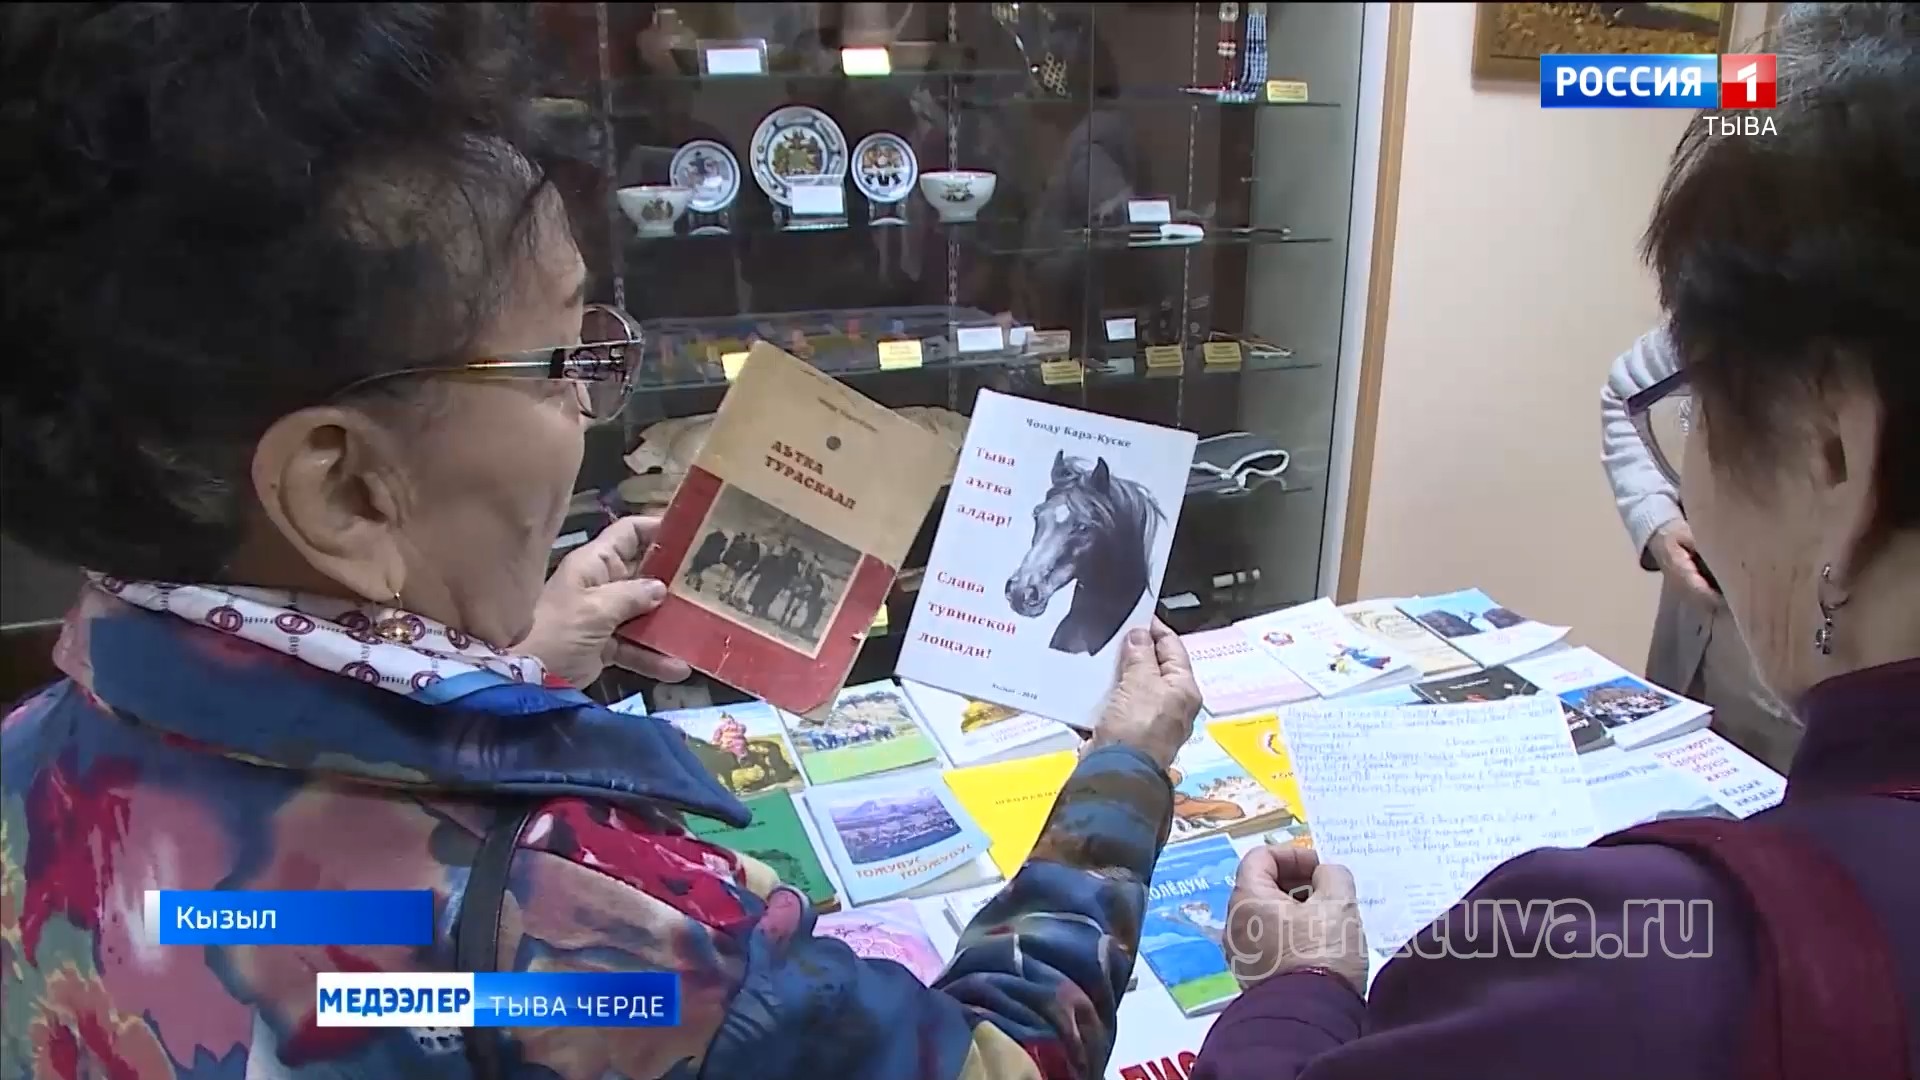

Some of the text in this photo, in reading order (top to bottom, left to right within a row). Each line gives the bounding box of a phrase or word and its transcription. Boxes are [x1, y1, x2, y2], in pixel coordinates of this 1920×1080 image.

[770, 440, 824, 475] АЪТКА
[976, 447, 1016, 467] Тыва
[965, 476, 1012, 496] аътка
[957, 503, 1013, 528] алдар!
[936, 571, 986, 594] Слава
[928, 601, 1017, 635] тувинской
